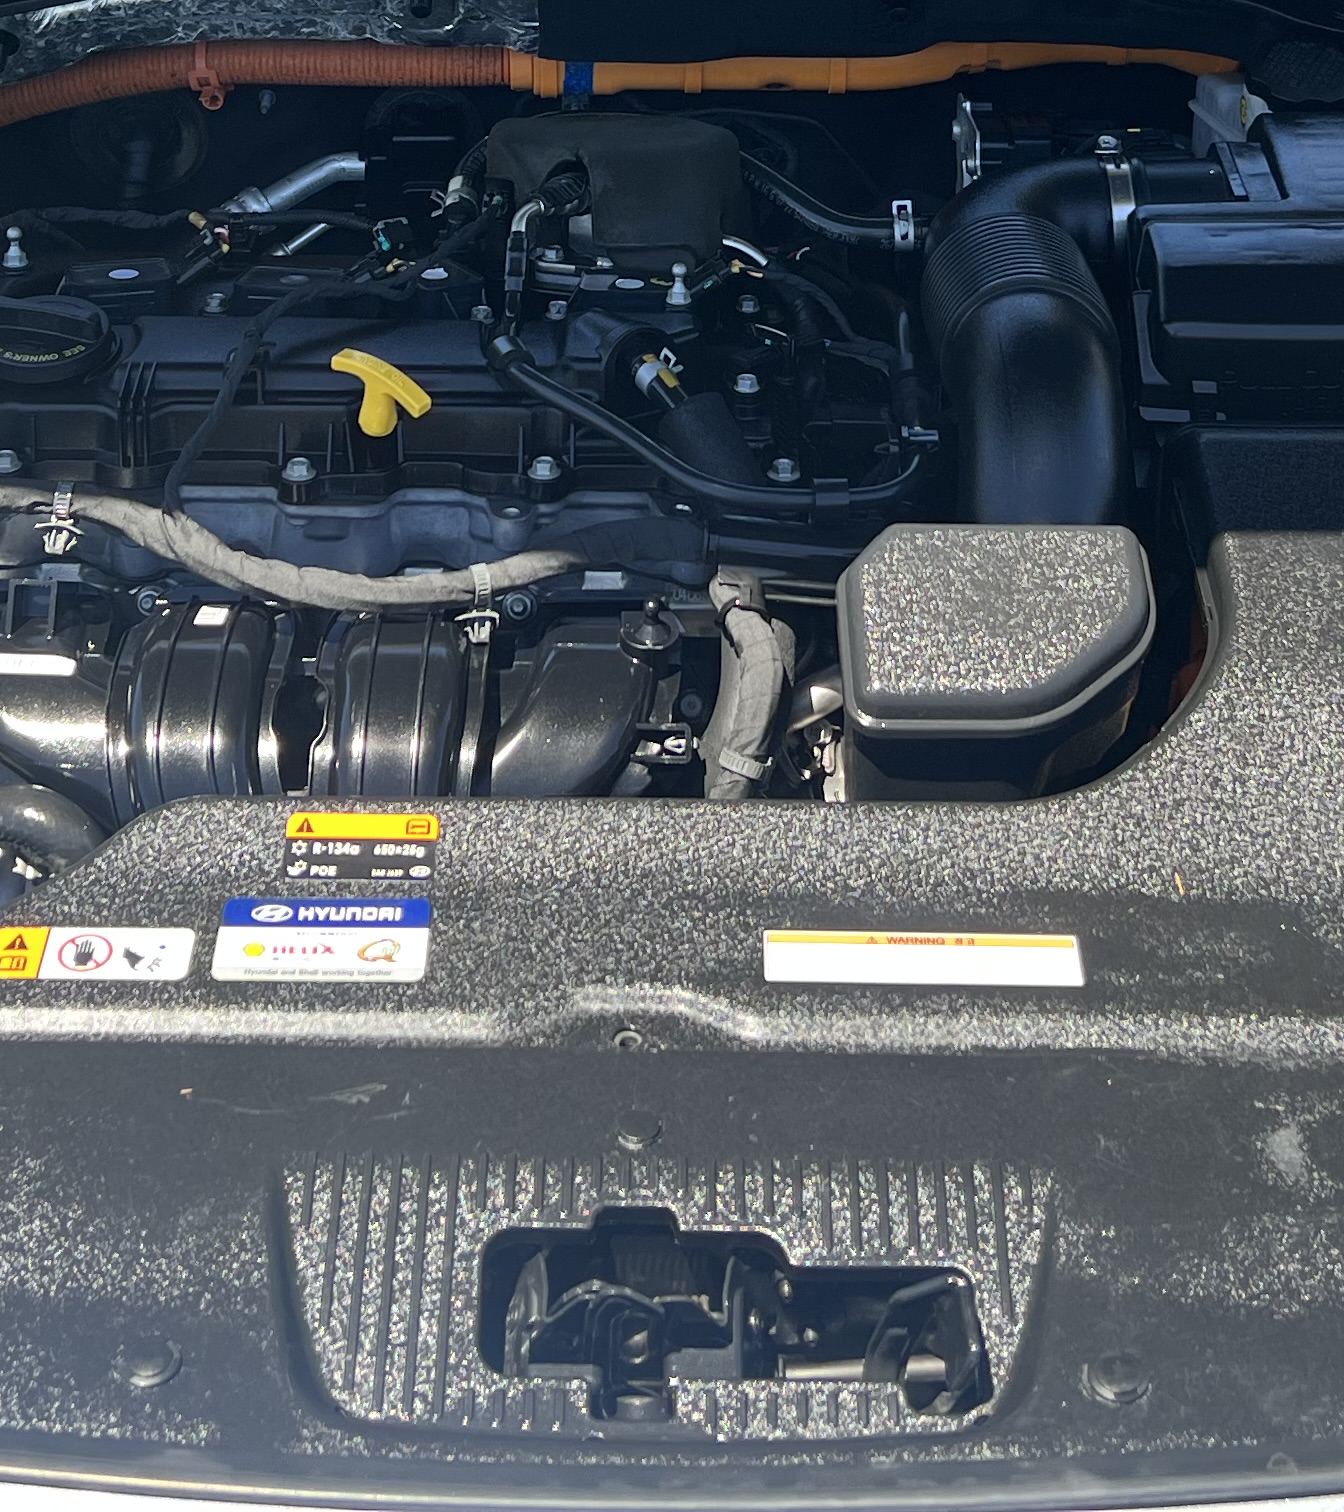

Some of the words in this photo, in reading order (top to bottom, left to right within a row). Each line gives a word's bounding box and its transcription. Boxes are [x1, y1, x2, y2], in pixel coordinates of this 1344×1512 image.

[3, 351, 59, 362] OWNER'S
[312, 841, 361, 856] R-134a
[310, 865, 338, 877] POE
[297, 906, 403, 922] HYUNDAI
[886, 936, 946, 945] WARNING
